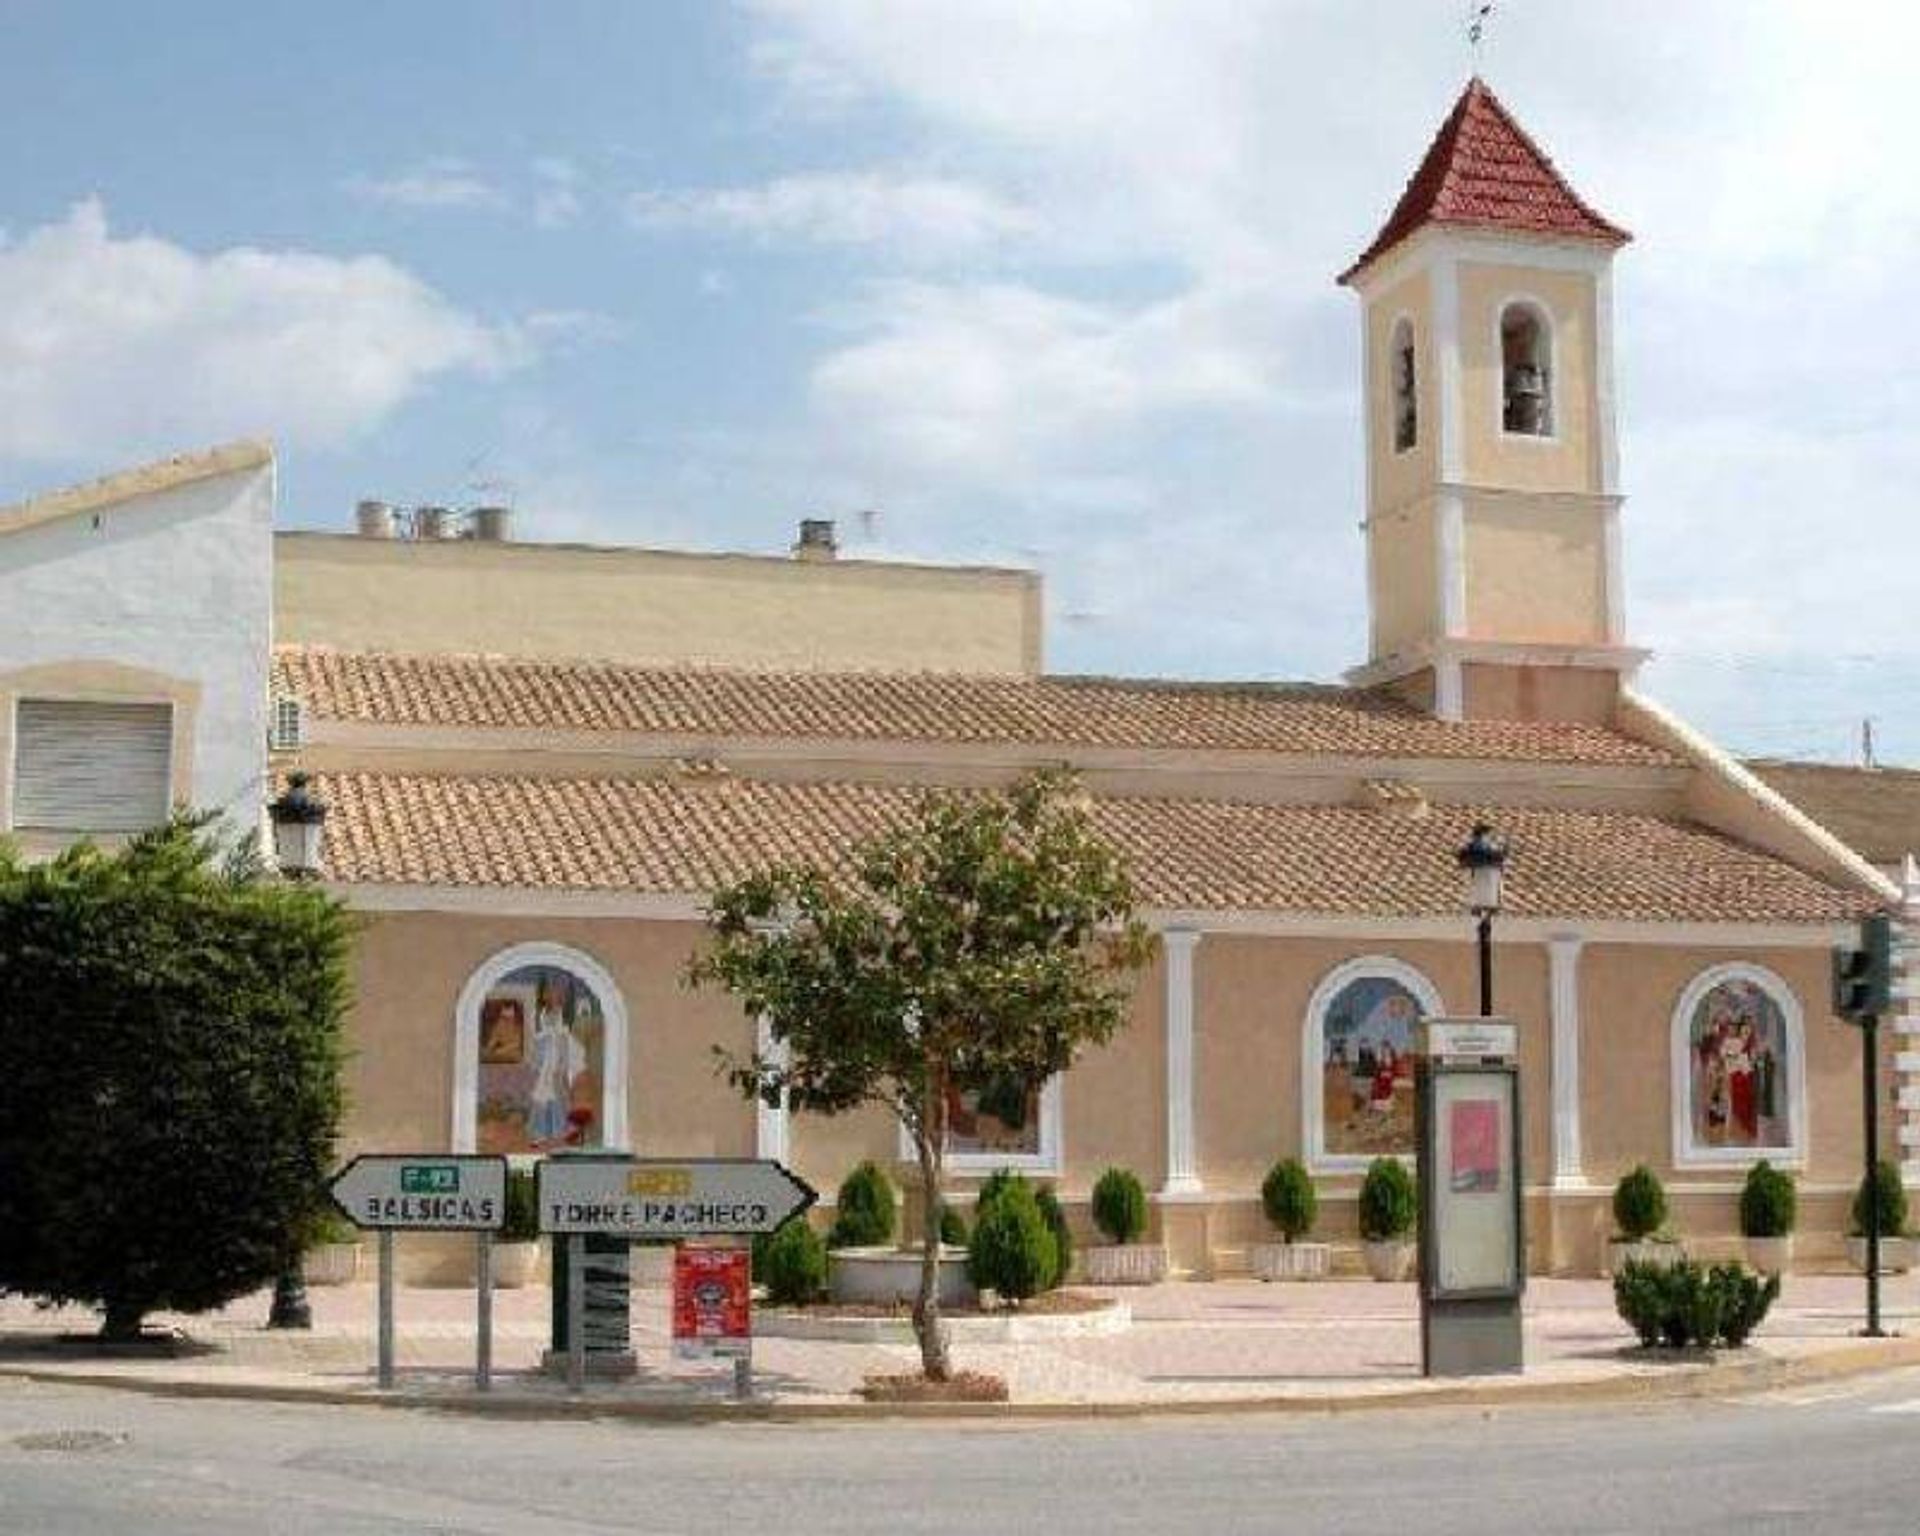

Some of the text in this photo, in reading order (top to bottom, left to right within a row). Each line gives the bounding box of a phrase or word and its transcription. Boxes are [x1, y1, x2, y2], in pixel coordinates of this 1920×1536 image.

[367, 1197, 494, 1221] BALSICAS
[551, 1203, 769, 1225] TORRE PACHECO
